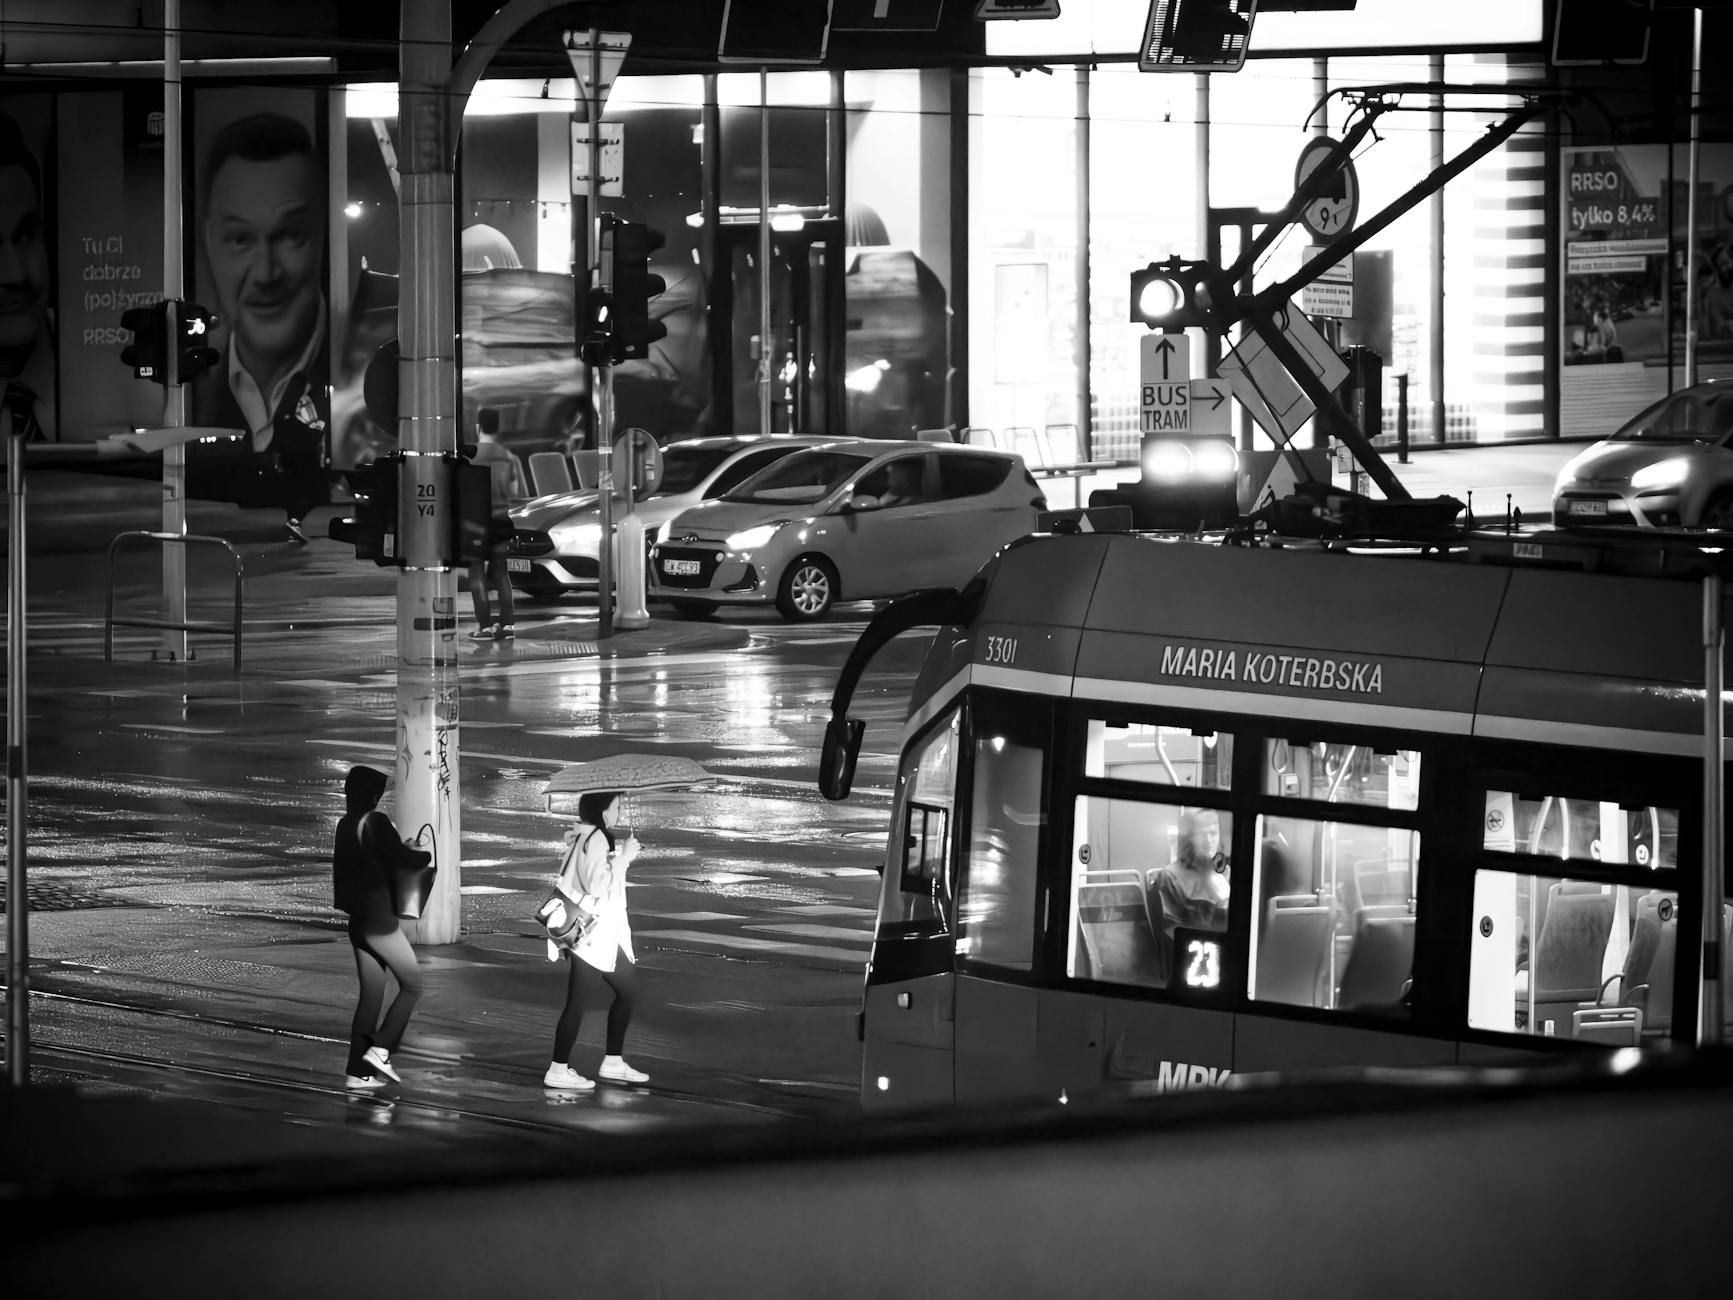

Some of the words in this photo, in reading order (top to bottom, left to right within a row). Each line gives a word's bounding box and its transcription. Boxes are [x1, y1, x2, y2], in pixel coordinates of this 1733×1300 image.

[1571, 171, 1618, 192] RRSO
[1572, 206, 1613, 230] tylko
[1617, 203, 1656, 226] 8,4%
[82, 237, 103, 254] Tu
[1143, 386, 1187, 406] BUS
[1143, 409, 1188, 430] TRAM
[985, 635, 1017, 663] 3301
[1160, 645, 1236, 681] MARIA
[1242, 652, 1382, 694] KOTERBSKA
[1187, 940, 1220, 987] 23
